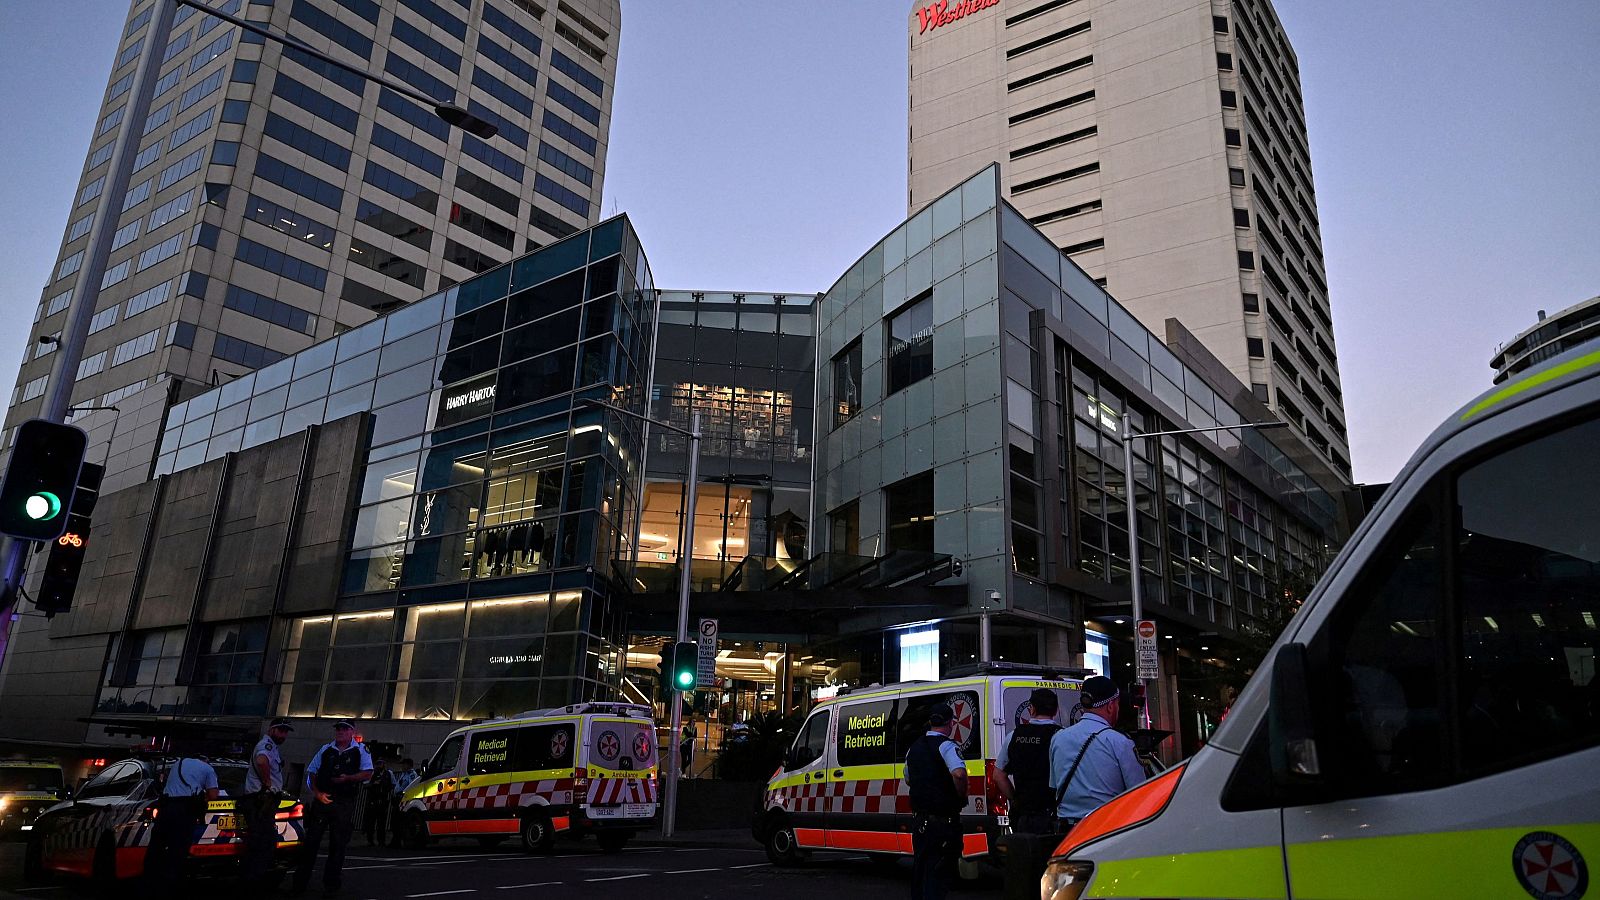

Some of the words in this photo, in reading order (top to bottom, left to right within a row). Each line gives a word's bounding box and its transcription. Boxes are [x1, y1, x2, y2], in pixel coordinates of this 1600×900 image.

[446, 391, 470, 411] HARRY
[1035, 681, 1072, 689] PARAMEDIC
[848, 712, 885, 731] Medical
[477, 737, 508, 751] Medical
[844, 731, 886, 749] Retrieval
[1015, 736, 1041, 744] POLICE
[474, 750, 507, 763] Retrieval
